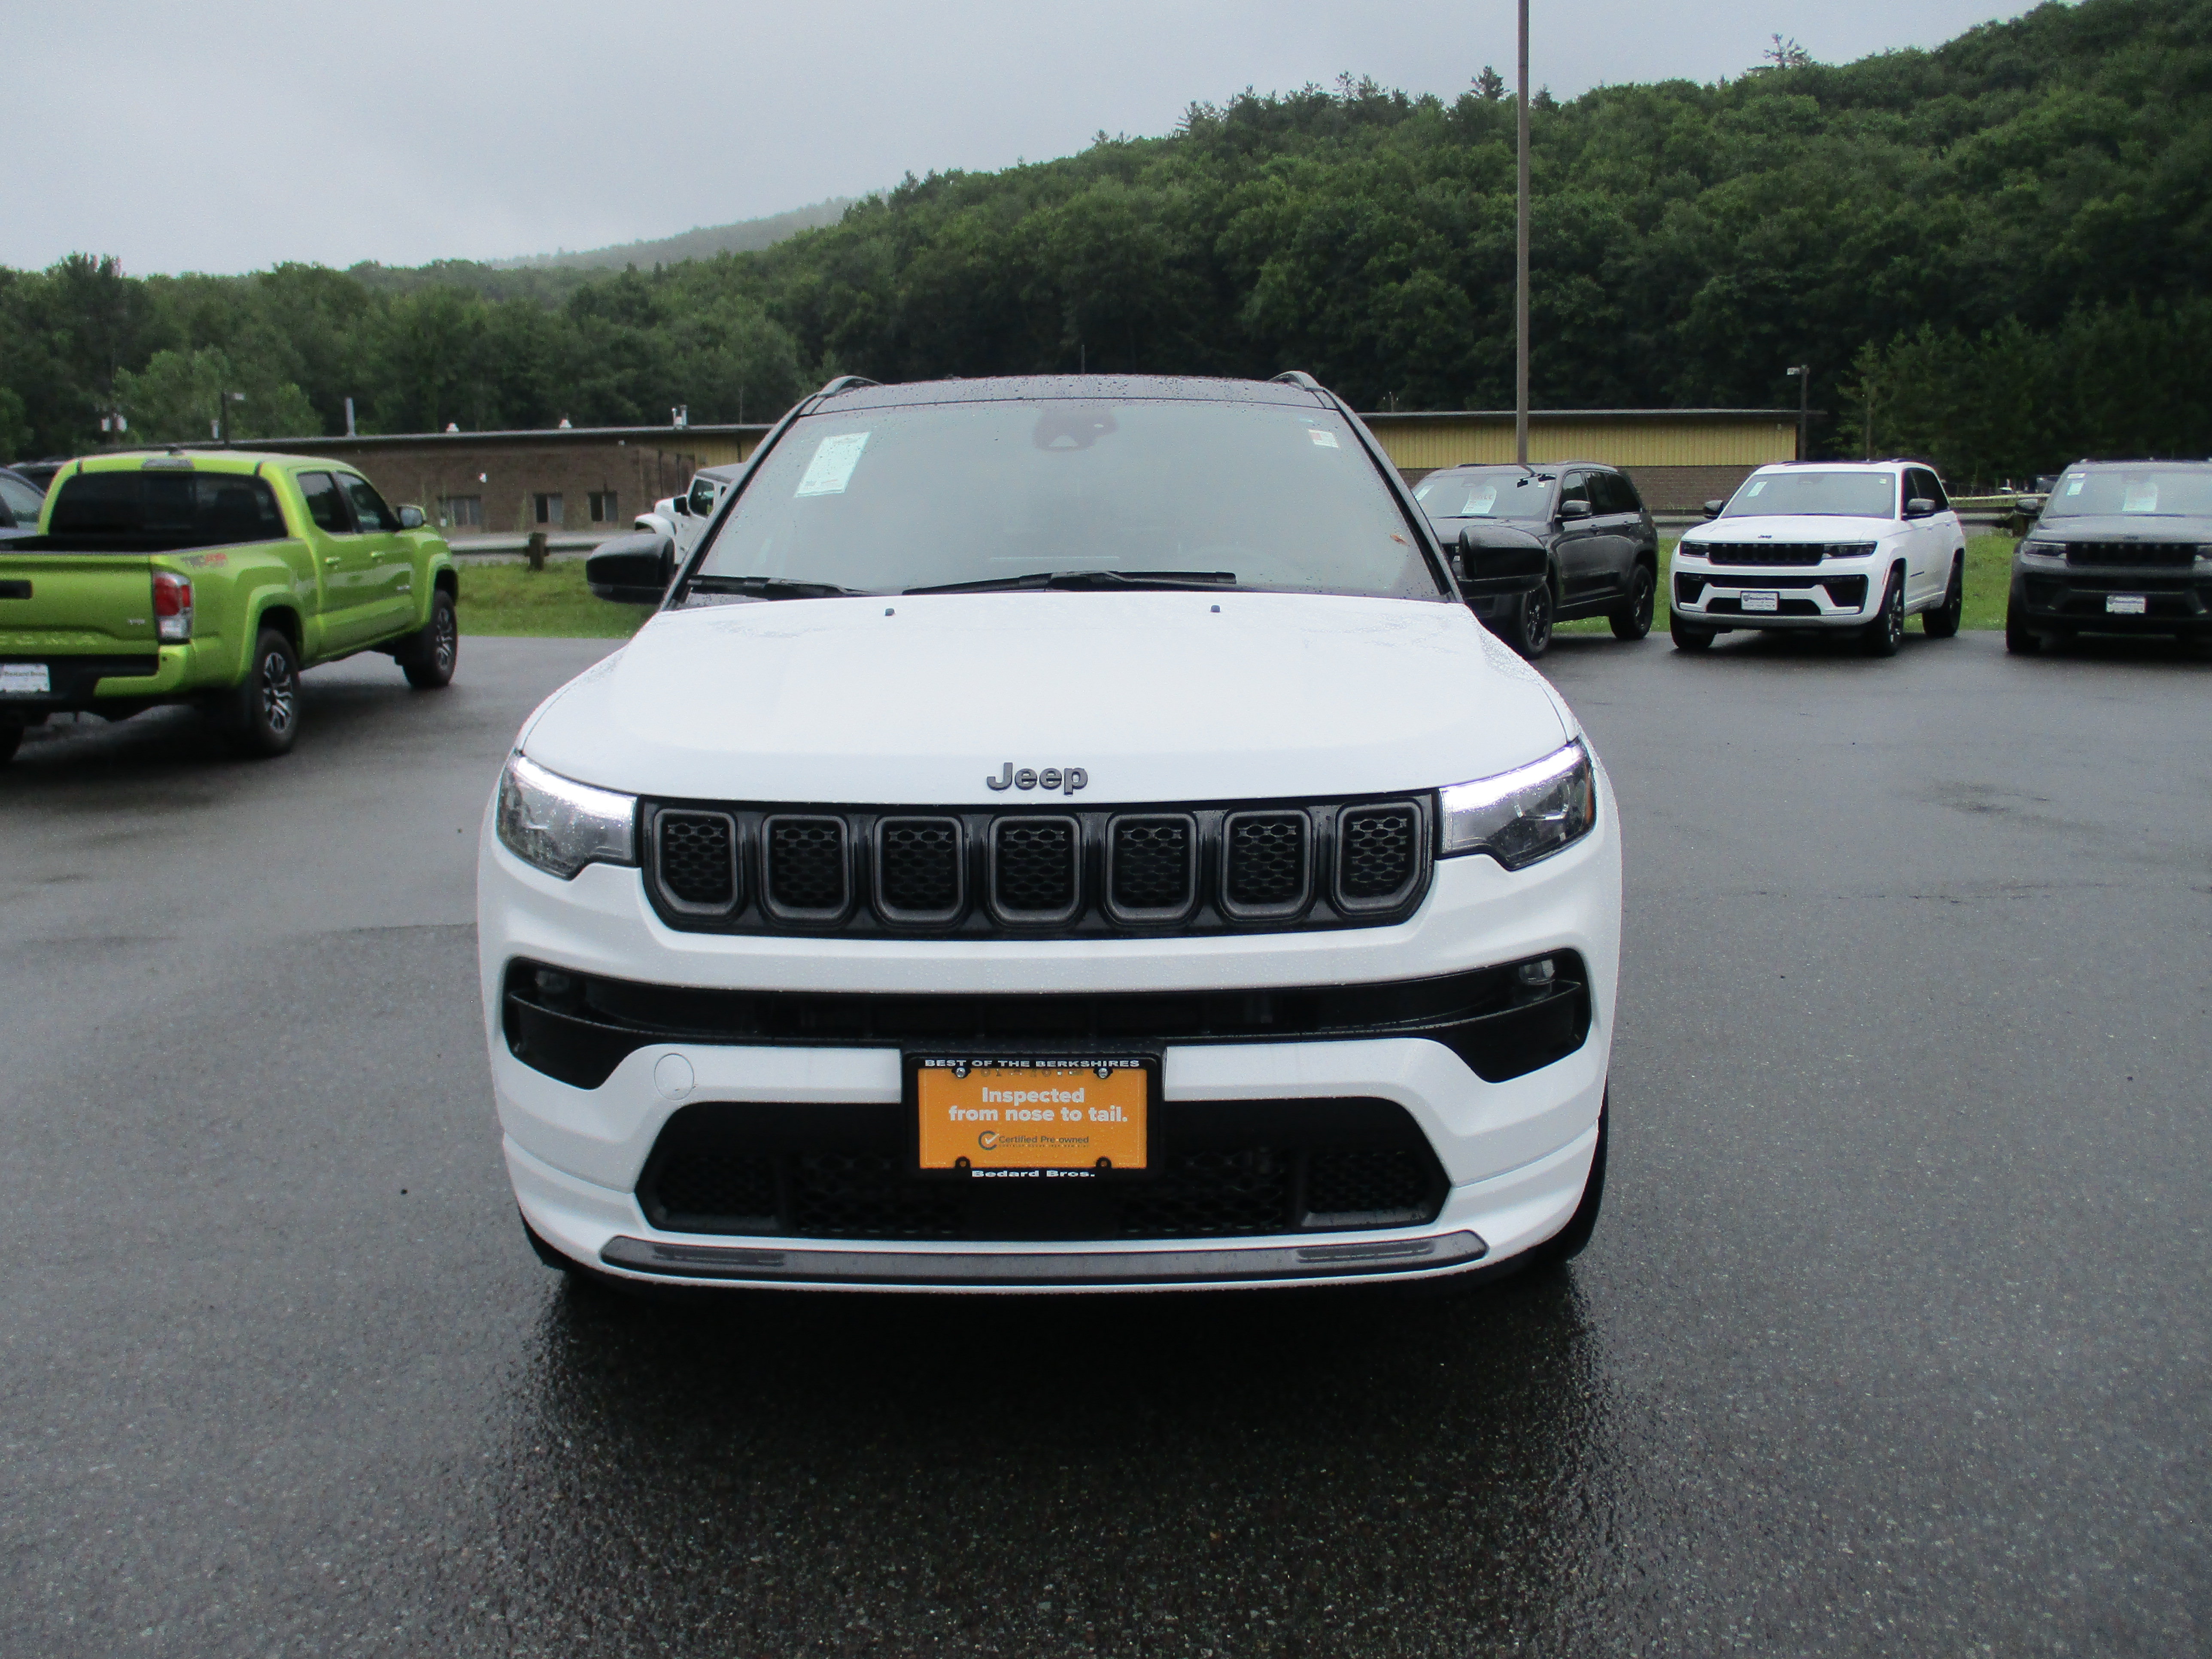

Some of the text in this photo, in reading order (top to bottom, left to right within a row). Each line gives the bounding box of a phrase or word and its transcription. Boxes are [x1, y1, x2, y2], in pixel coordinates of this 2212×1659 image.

[987, 762, 1088, 796] Jeep
[982, 1087, 1085, 1106] Inspected
[948, 1105, 1128, 1122] from nose to tail.
[999, 1135, 1038, 1143] Certified
